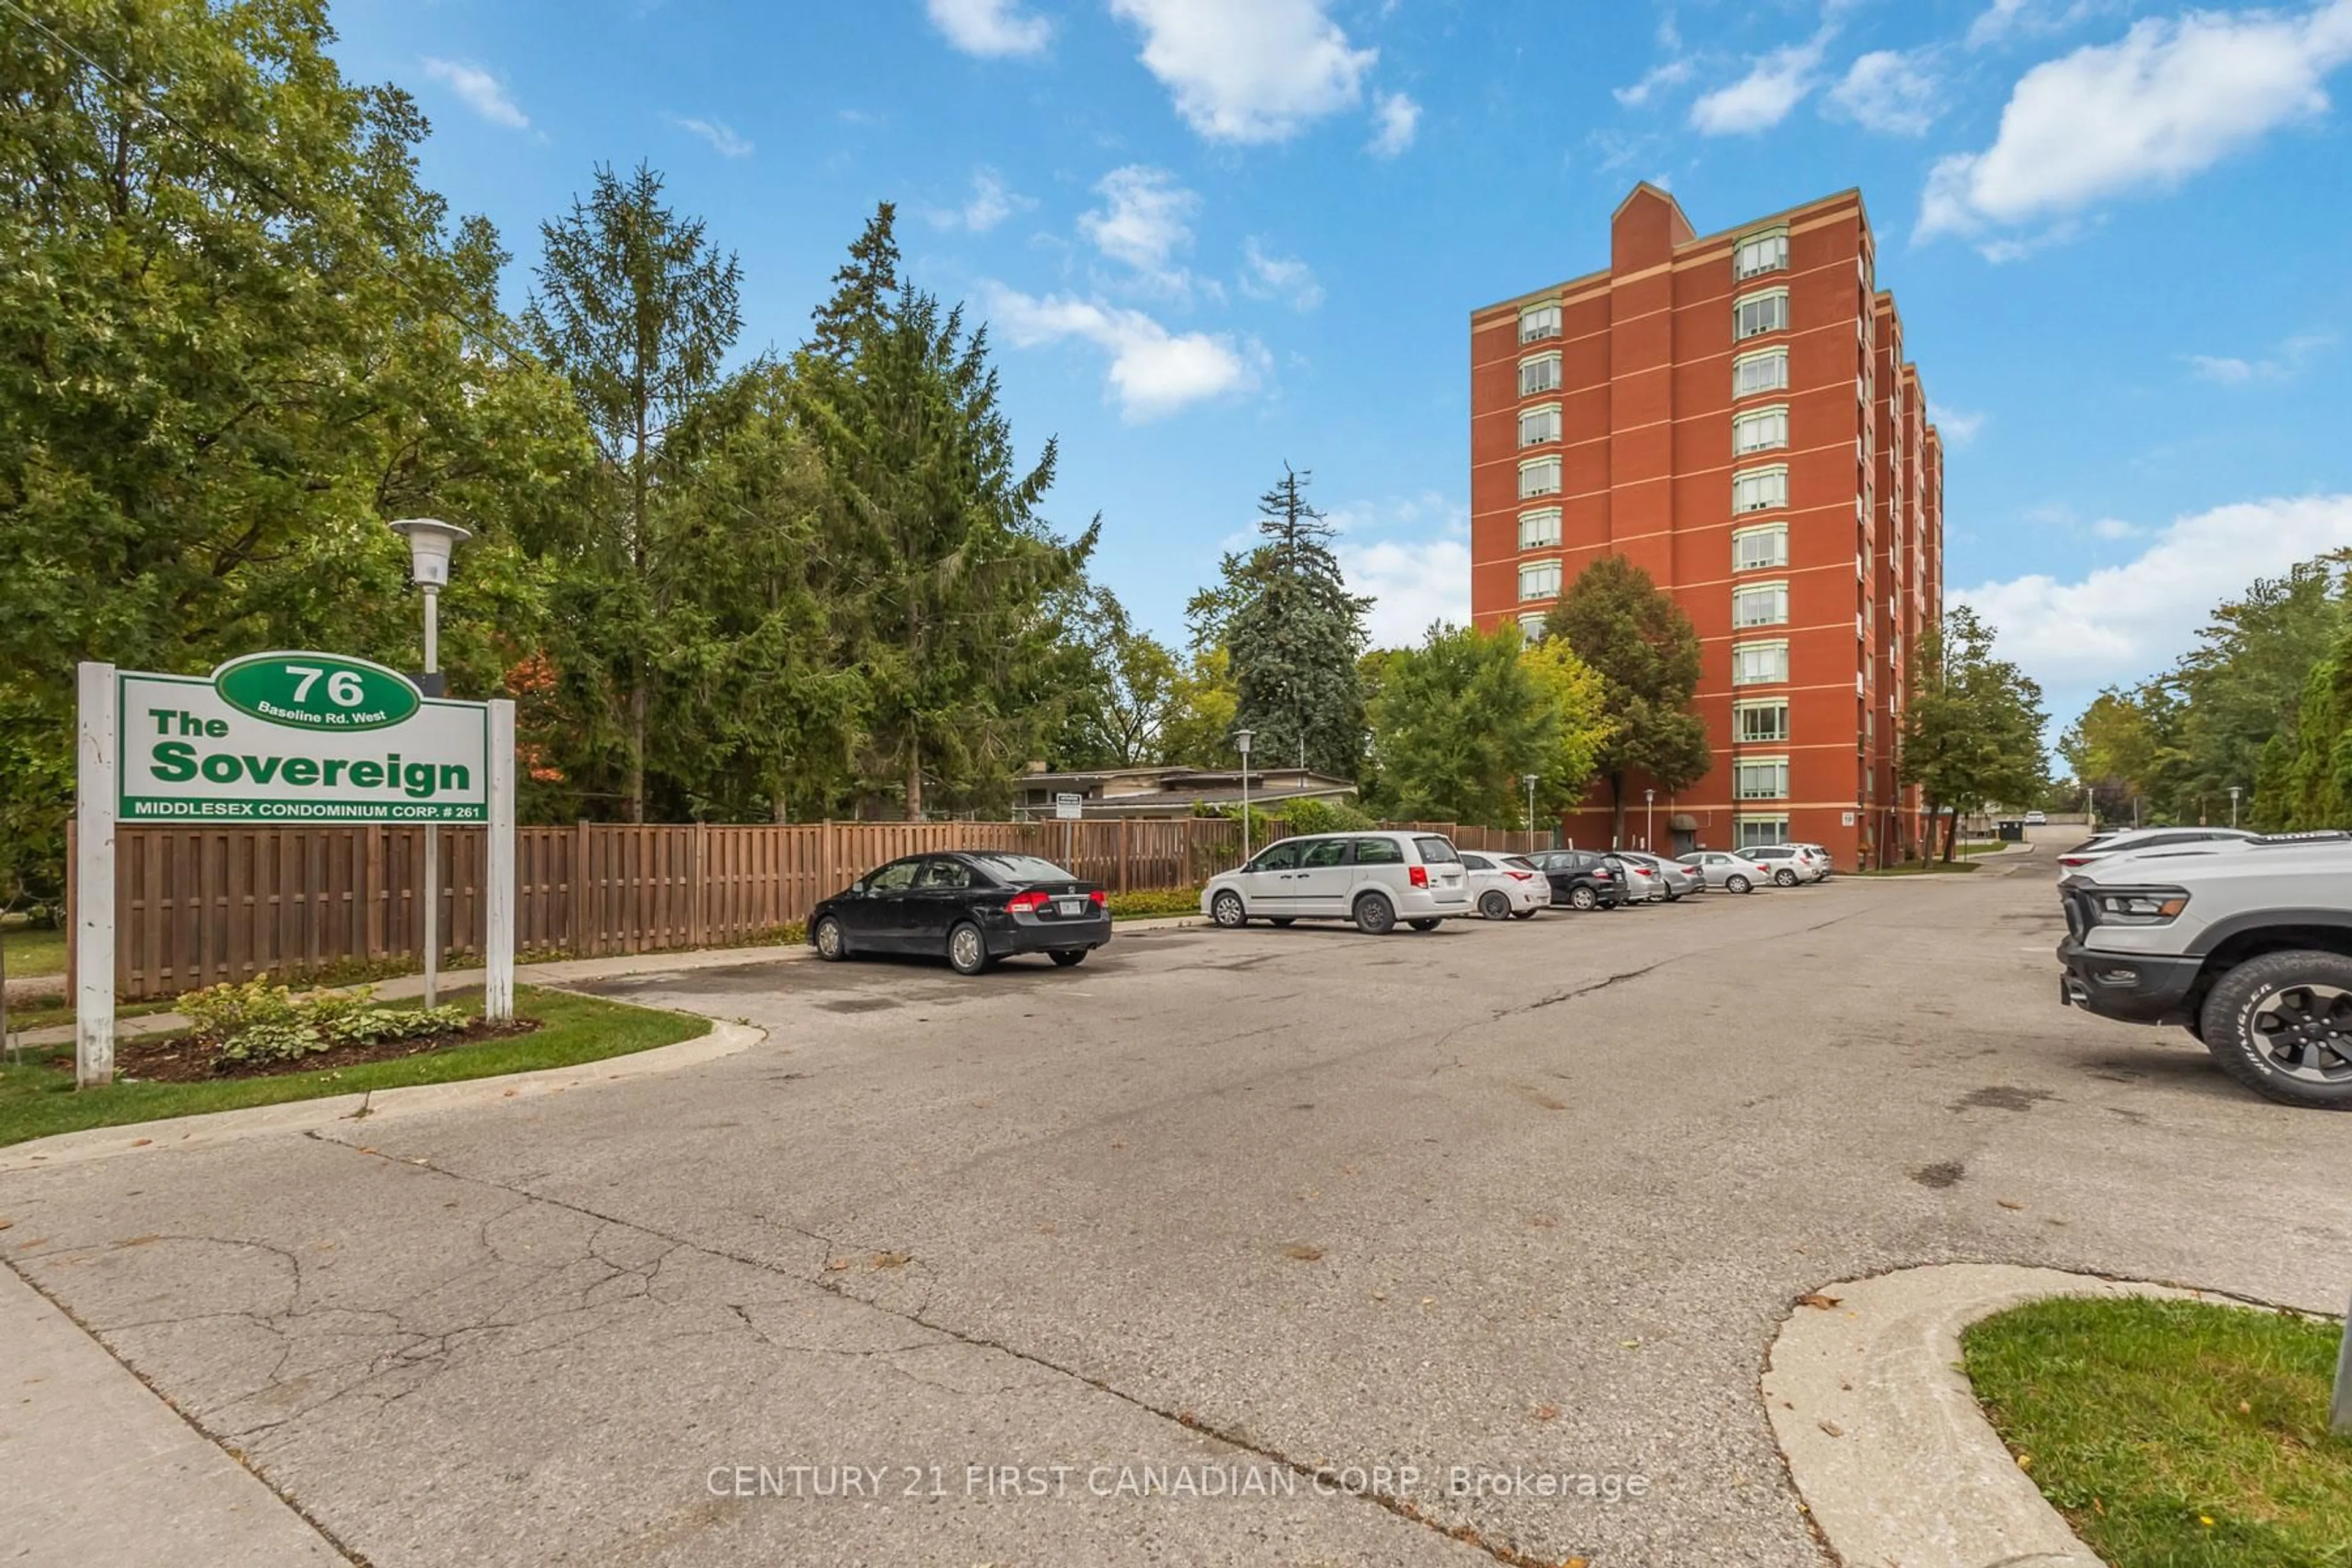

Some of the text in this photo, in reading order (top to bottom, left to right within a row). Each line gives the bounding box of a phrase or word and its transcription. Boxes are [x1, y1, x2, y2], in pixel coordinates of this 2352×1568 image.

[285, 665, 364, 707] 76
[149, 709, 229, 737] The
[257, 701, 387, 724] Baseline Rd. West
[149, 741, 470, 798] Sovereign
[135, 801, 480, 818] MIDDLESEX CONDOMINIUM CORP. # 261
